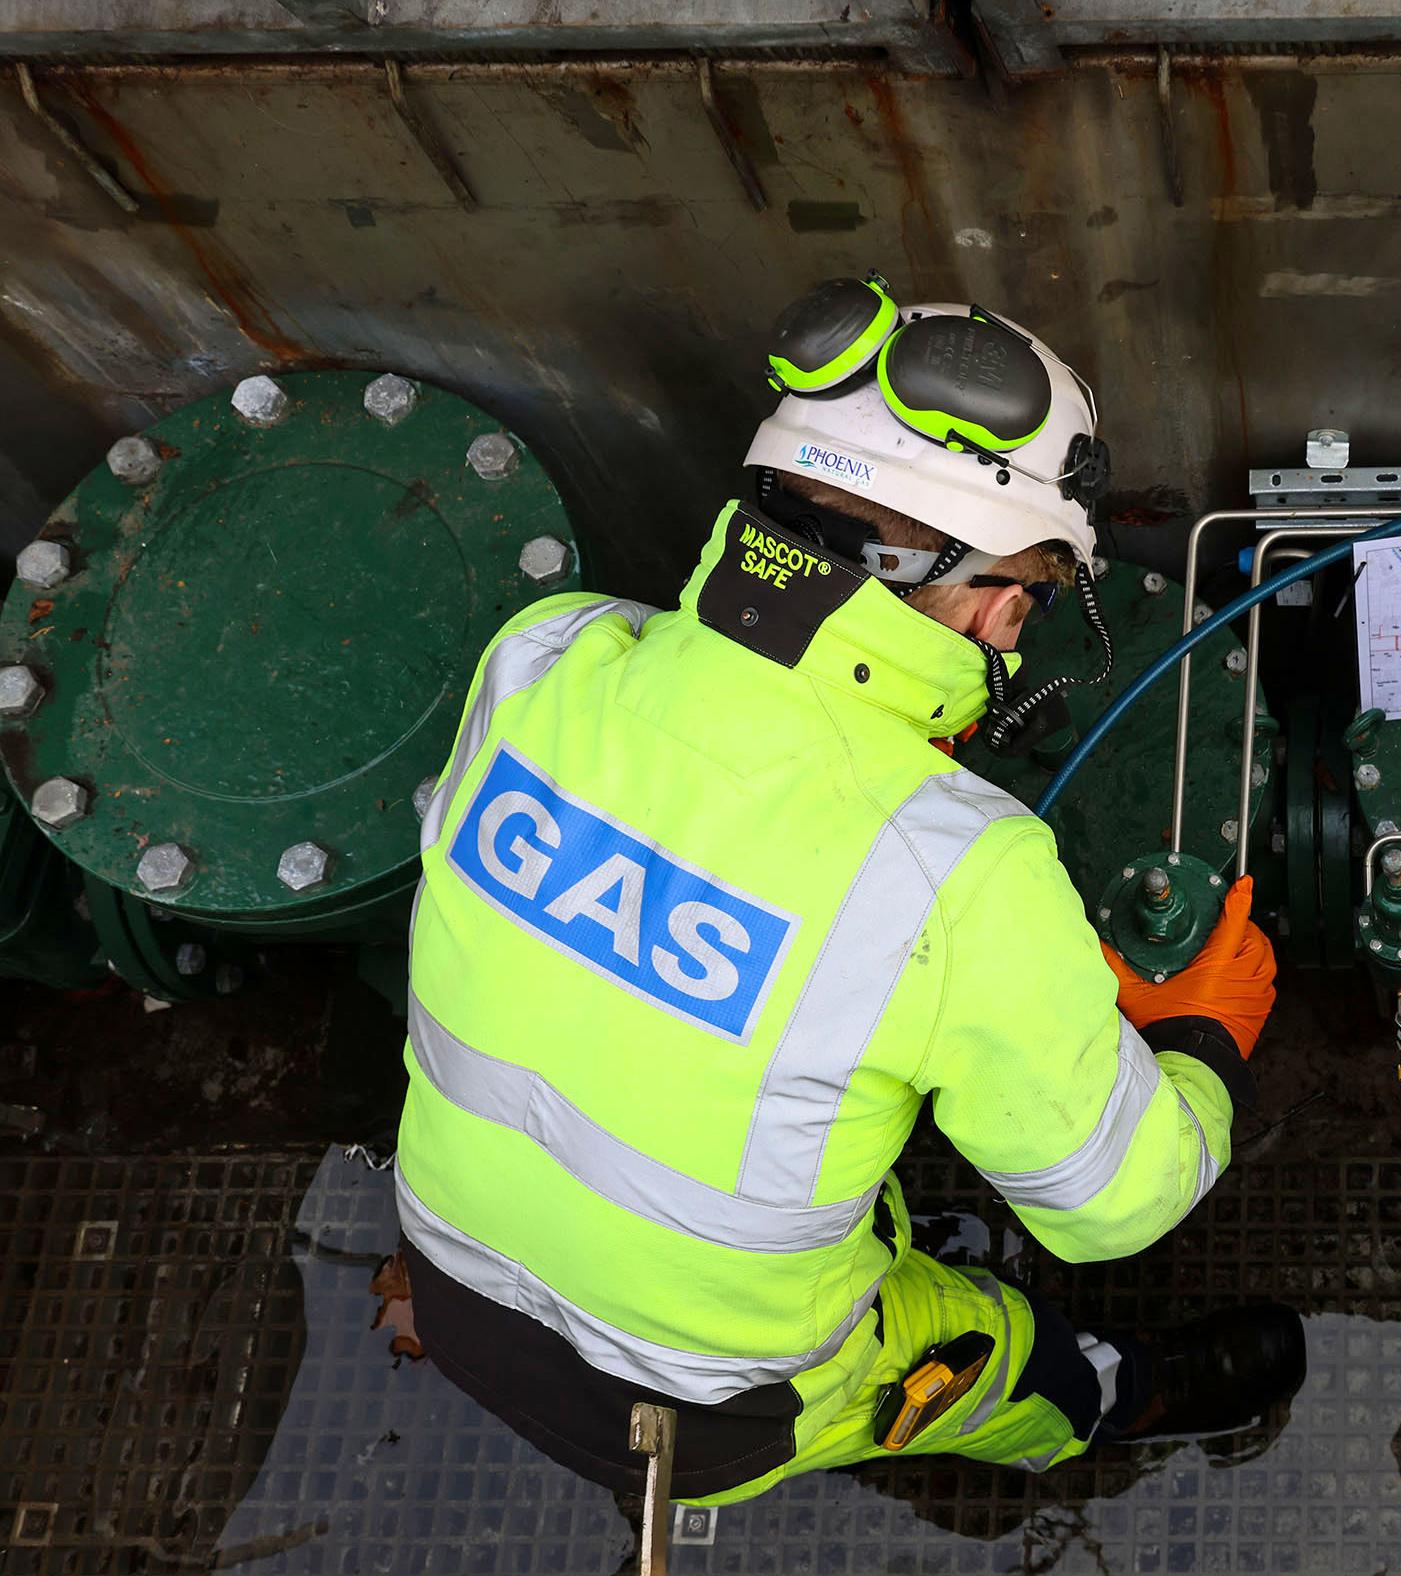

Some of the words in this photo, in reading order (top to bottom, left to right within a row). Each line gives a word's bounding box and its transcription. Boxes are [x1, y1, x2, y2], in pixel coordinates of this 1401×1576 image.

[807, 446, 874, 481] PHOENIX
[740, 550, 793, 590] SAFE
[477, 790, 751, 1001] GAS
